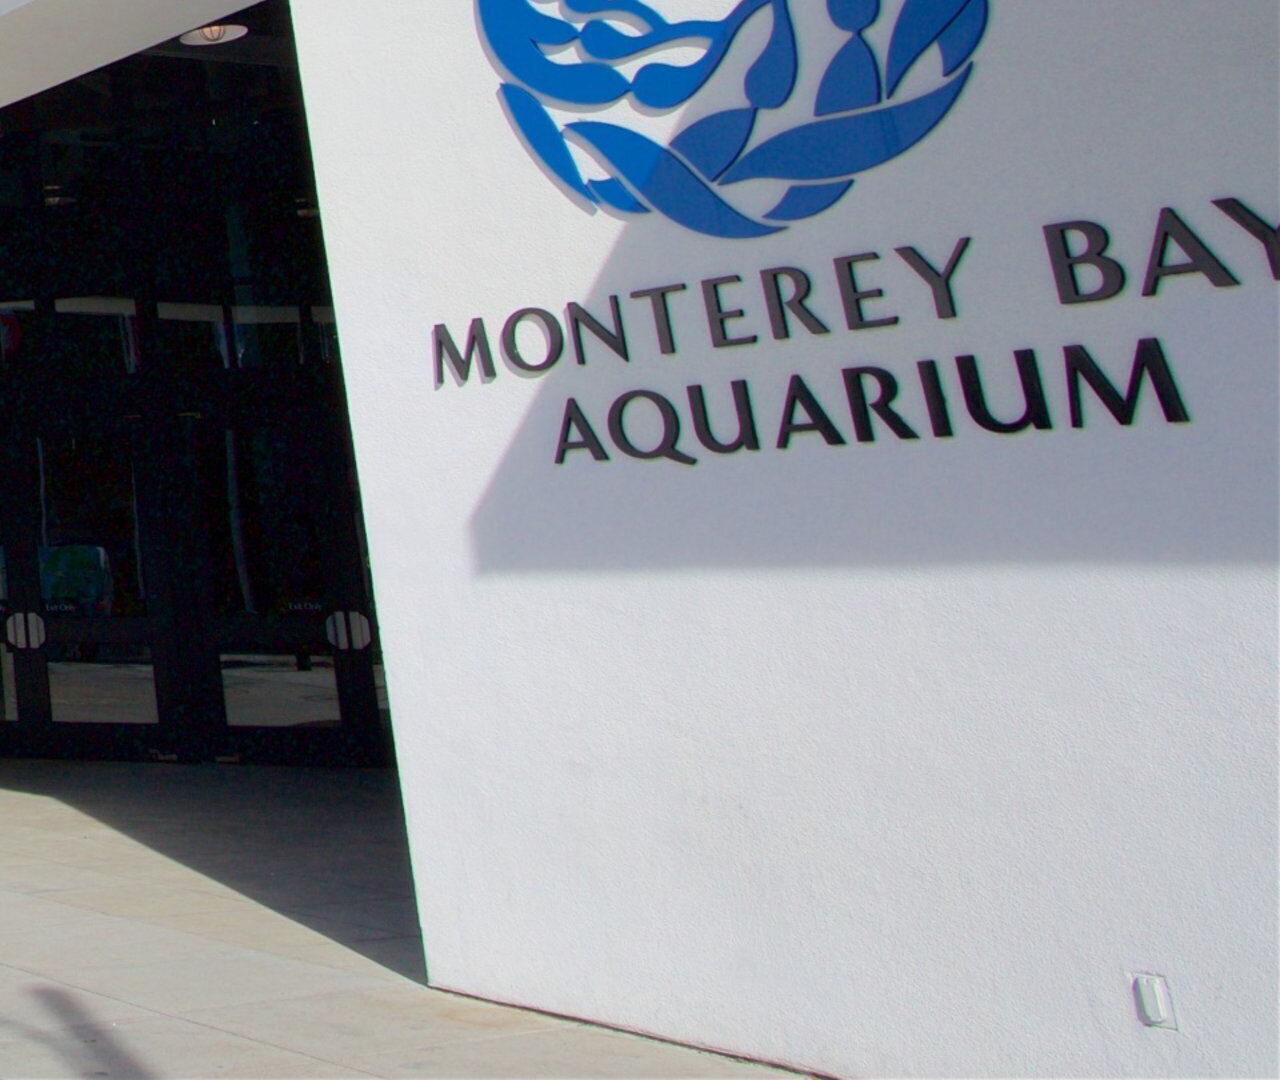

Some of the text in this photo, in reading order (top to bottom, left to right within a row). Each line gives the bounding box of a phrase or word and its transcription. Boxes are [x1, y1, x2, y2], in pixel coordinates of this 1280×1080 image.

[432, 197, 1280, 390] MONTEREY BAY
[554, 337, 1192, 465] AQUARIUM
